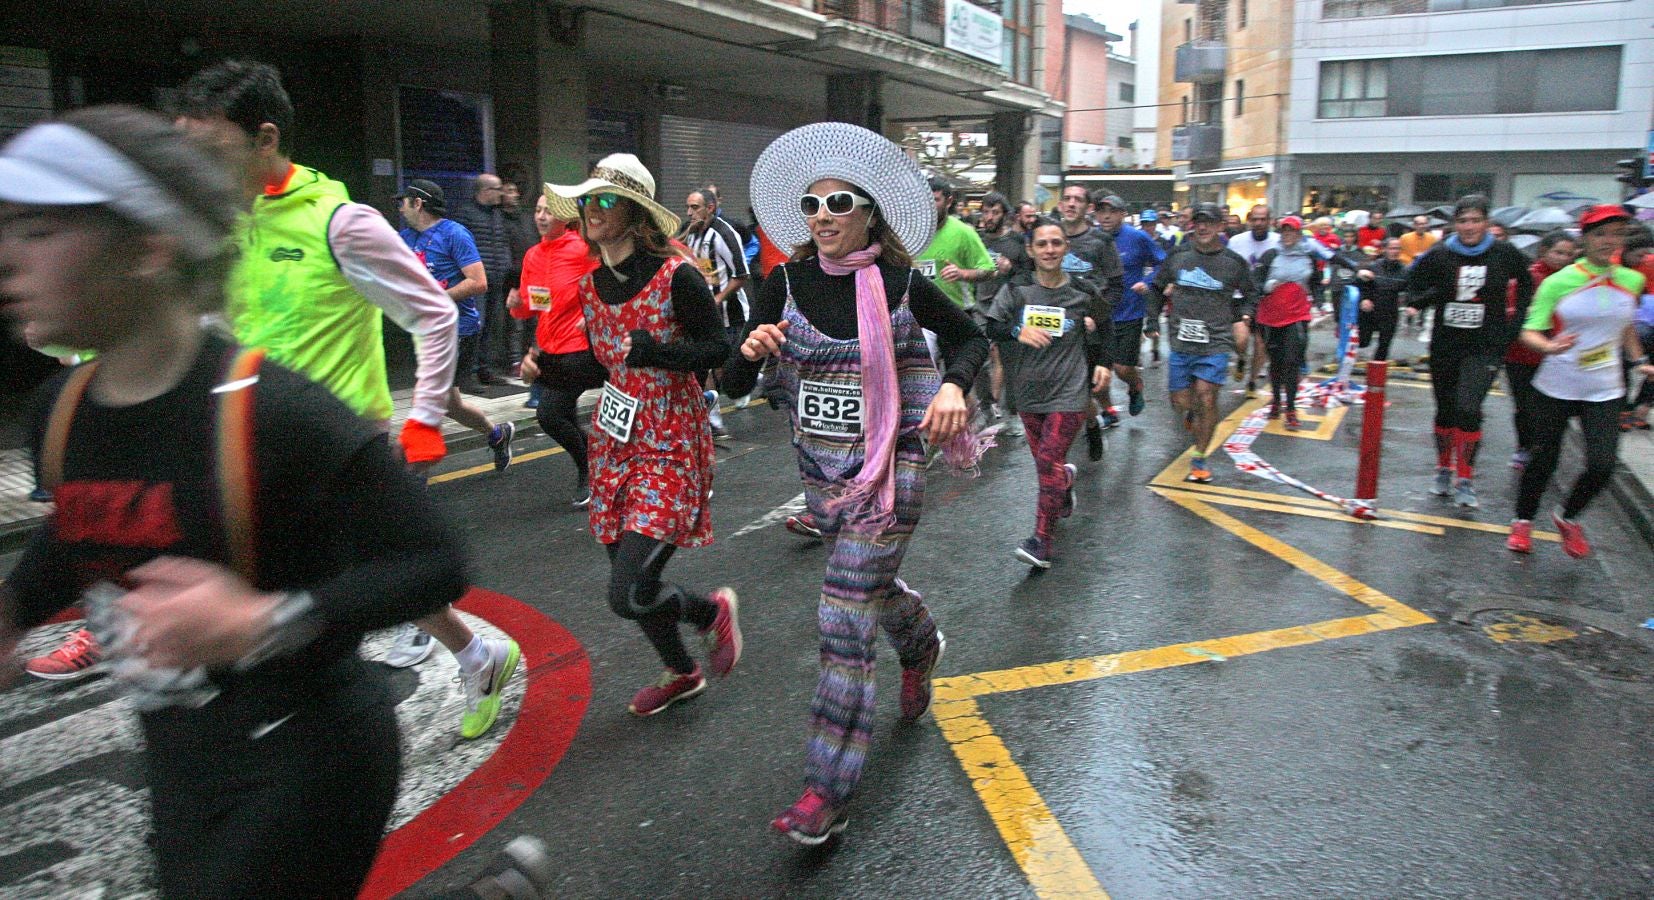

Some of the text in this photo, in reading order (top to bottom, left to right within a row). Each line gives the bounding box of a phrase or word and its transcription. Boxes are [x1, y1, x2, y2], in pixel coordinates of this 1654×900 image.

[1027, 316, 1061, 328] 1353
[602, 396, 631, 426] 654
[804, 394, 860, 420] 632
